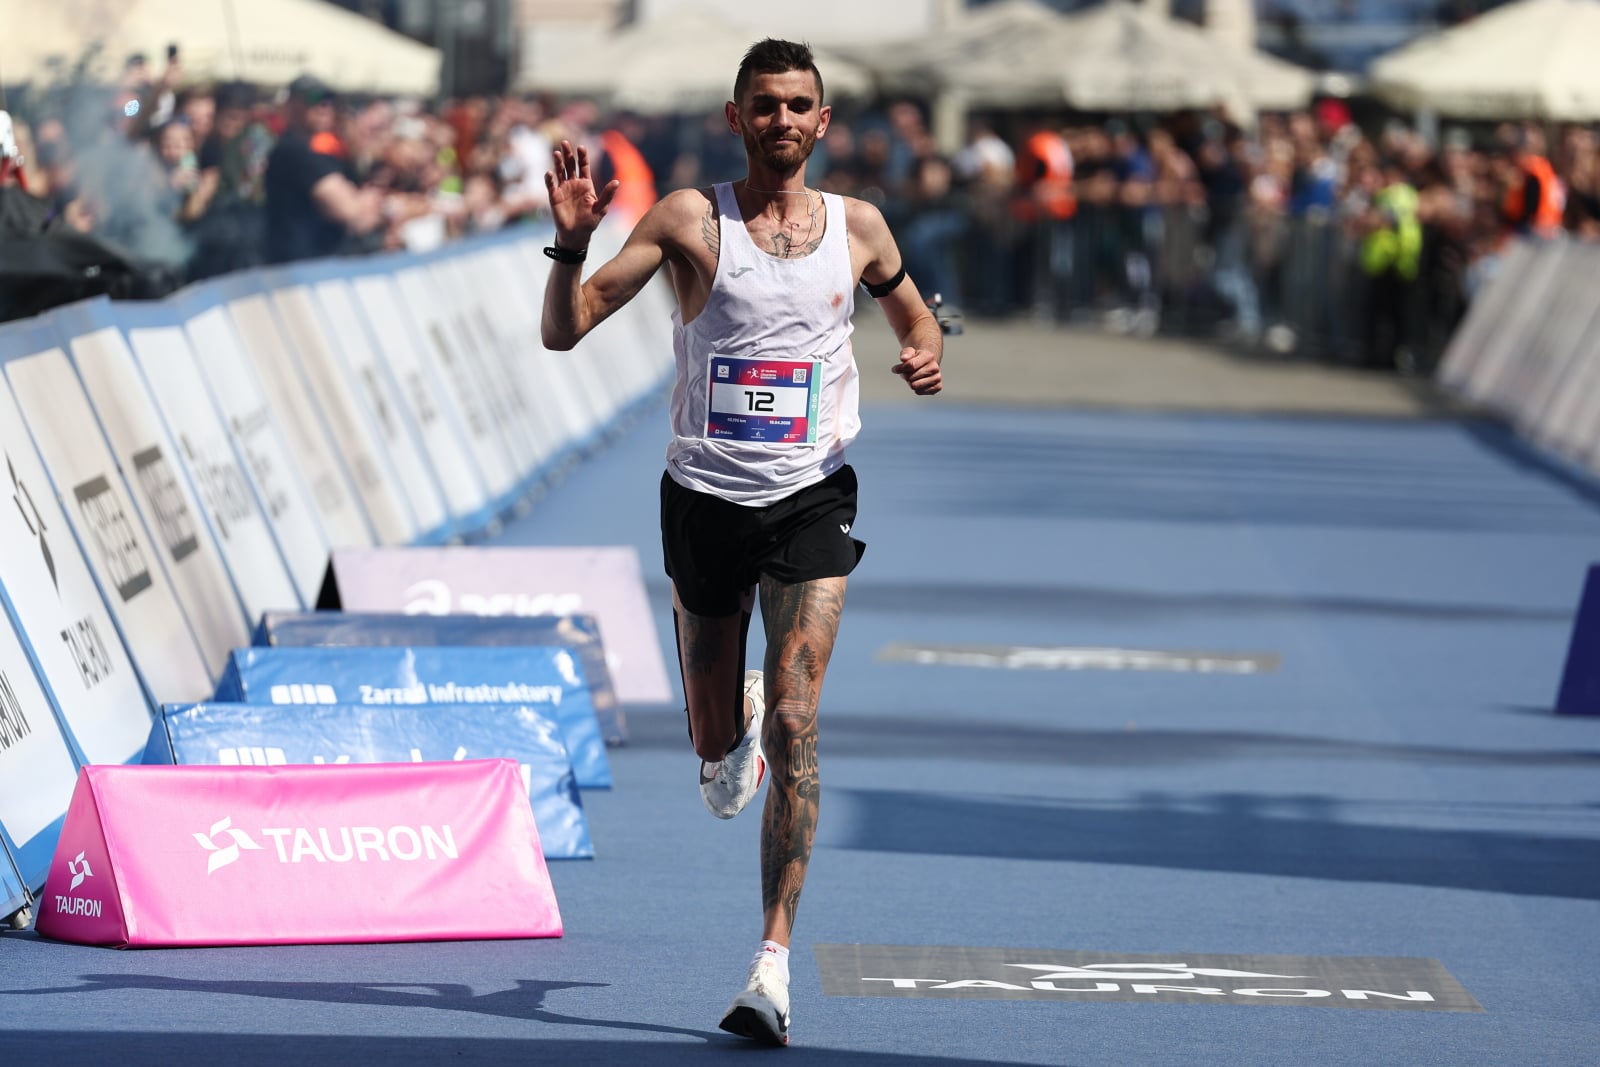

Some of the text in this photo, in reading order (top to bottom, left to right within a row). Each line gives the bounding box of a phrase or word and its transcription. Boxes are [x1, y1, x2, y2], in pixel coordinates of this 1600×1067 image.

[744, 391, 775, 412] 12
[429, 680, 563, 706] Infrastruktury
[261, 825, 459, 864] TAURON
[55, 894, 103, 919] TAURON
[861, 976, 1434, 1003] TAURON
